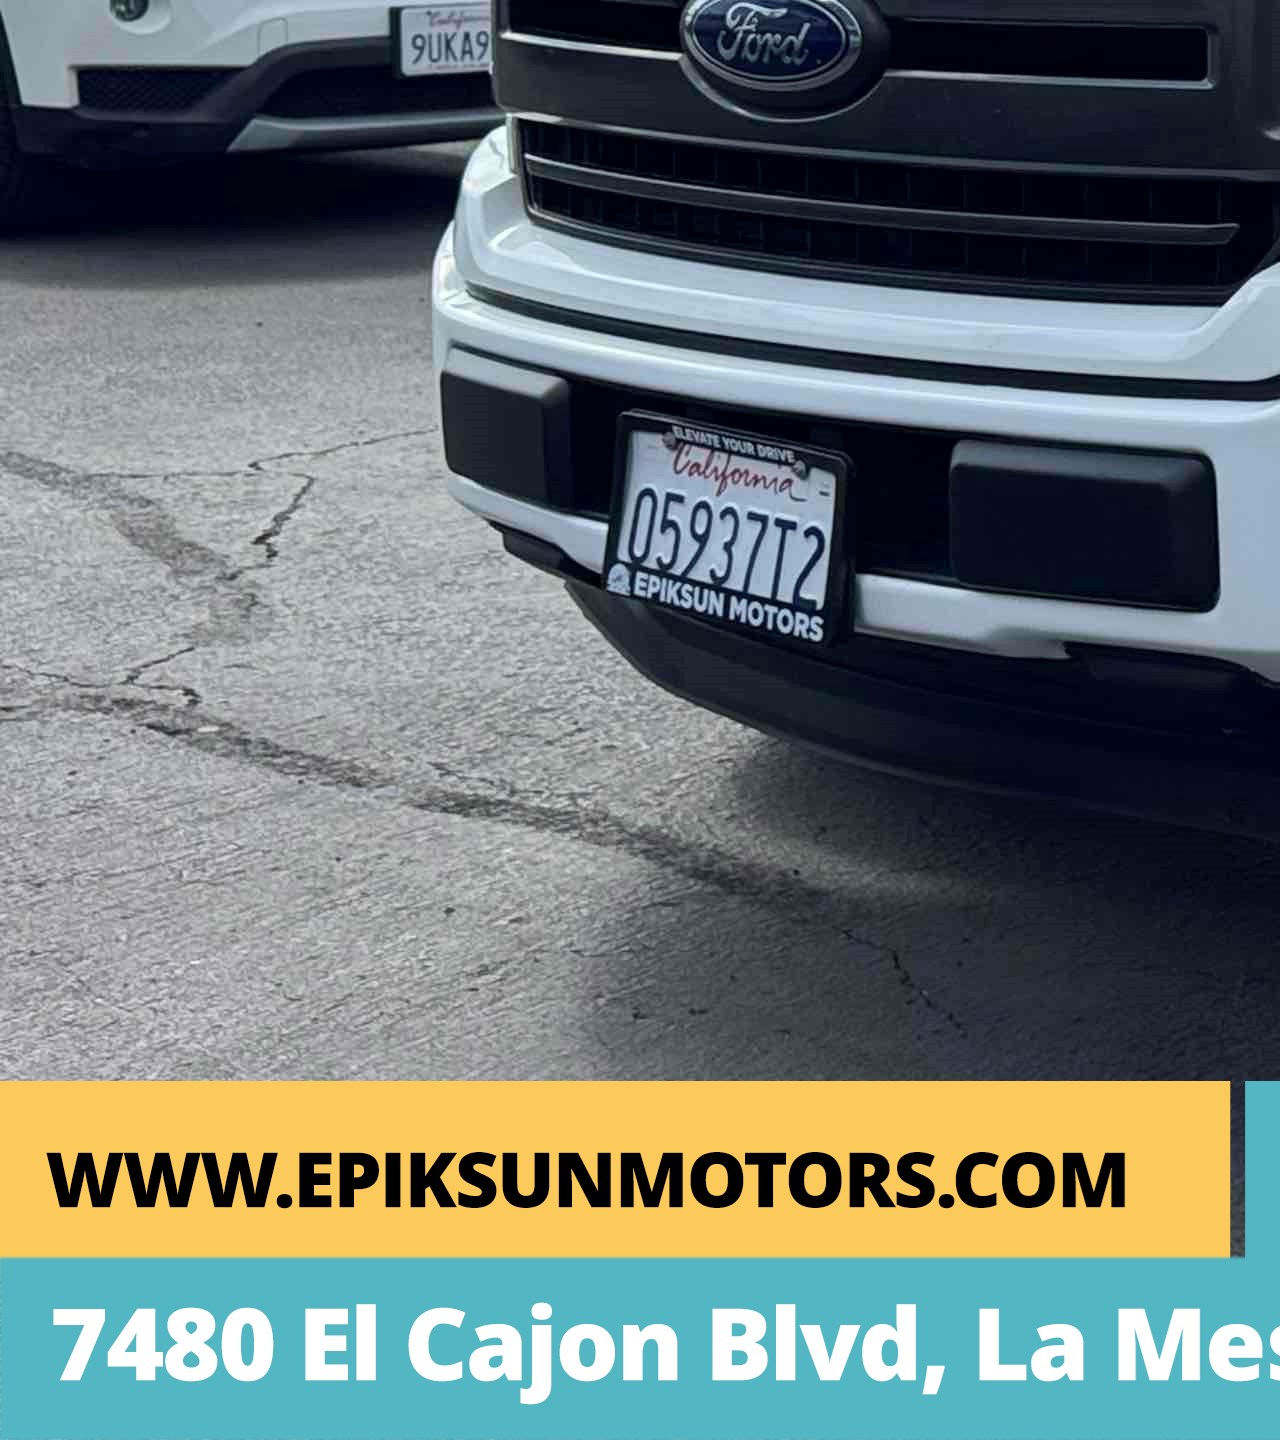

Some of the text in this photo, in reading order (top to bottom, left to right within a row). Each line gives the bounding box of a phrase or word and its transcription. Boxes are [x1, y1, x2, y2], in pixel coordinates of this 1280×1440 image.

[717, 1, 812, 65] Ford
[672, 425, 796, 462] ELEVATE YOUR DRIVE
[672, 444, 807, 501] California
[628, 487, 826, 610] 05937T2
[633, 571, 825, 643] EPIKSUN MOTORS
